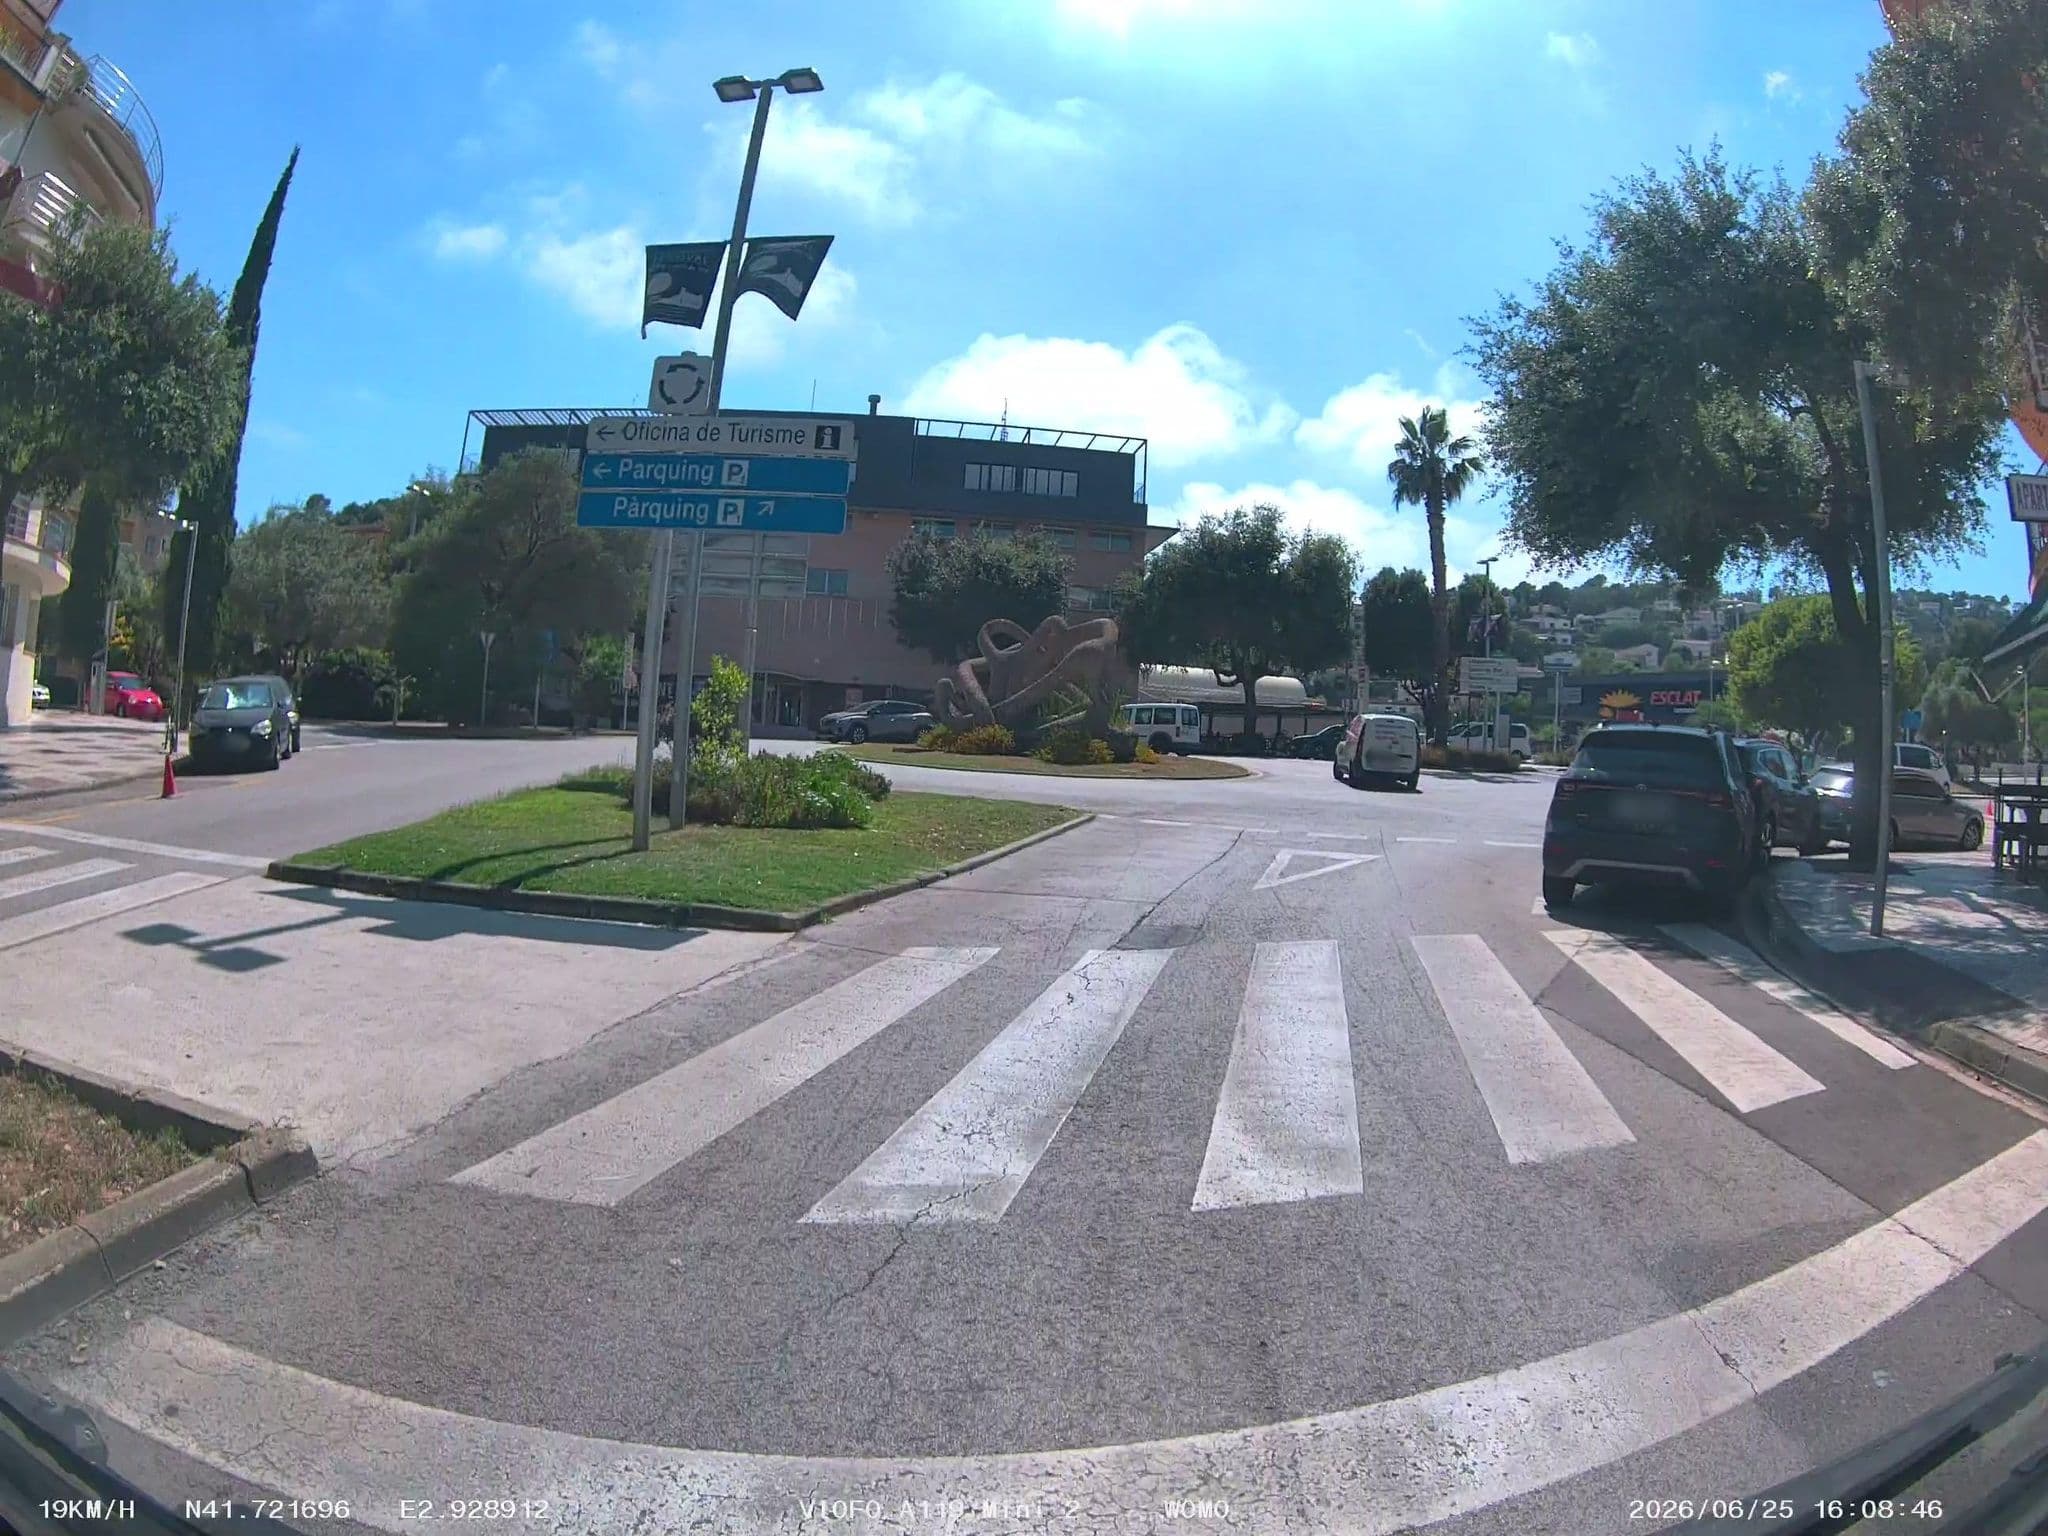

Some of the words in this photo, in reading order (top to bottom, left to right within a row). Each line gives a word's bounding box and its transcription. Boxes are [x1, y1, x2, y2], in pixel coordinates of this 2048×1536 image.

[622, 420, 690, 442] Oficina
[696, 422, 721, 442] de
[728, 422, 806, 445] Turisme
[618, 458, 715, 486] Parquing
[1650, 690, 1702, 705] ESCLAT
